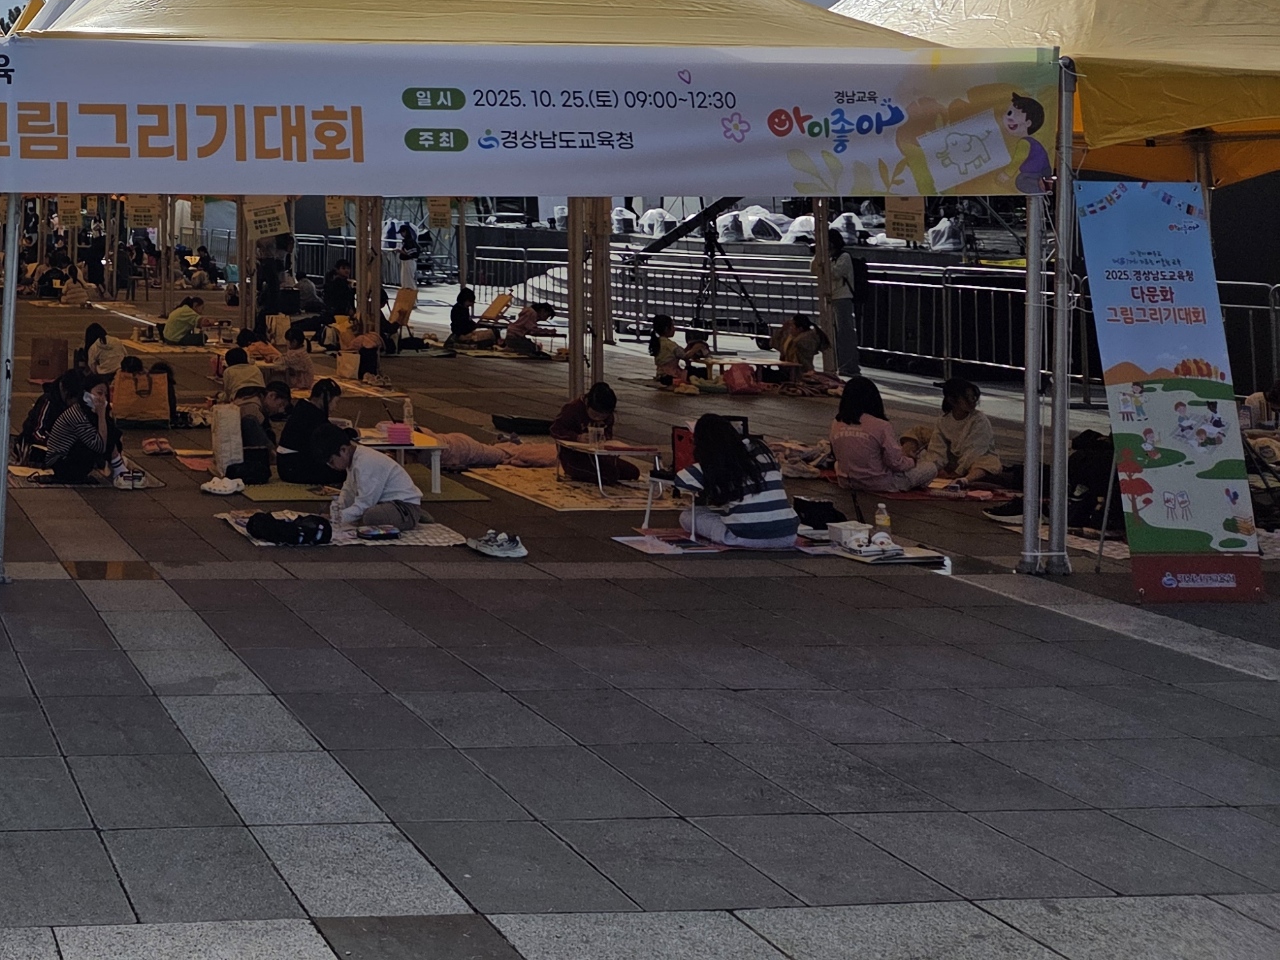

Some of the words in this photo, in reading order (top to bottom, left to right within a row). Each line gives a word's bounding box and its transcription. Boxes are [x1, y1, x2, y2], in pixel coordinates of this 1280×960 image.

[473, 89, 527, 108] 2025.
[531, 89, 556, 108] 10.
[560, 90, 619, 109] 25.(토)
[624, 90, 737, 109] 09:00~12:30
[834, 91, 879, 105] 경남교육
[768, 106, 905, 154] 아이좋아
[500, 130, 635, 150] 경상남도교육청
[1105, 270, 1132, 281] 2025.
[1132, 270, 1195, 282] 경상남도교육청
[1130, 286, 1175, 303] 다문화
[1106, 307, 1207, 325] 그림그리기대회
